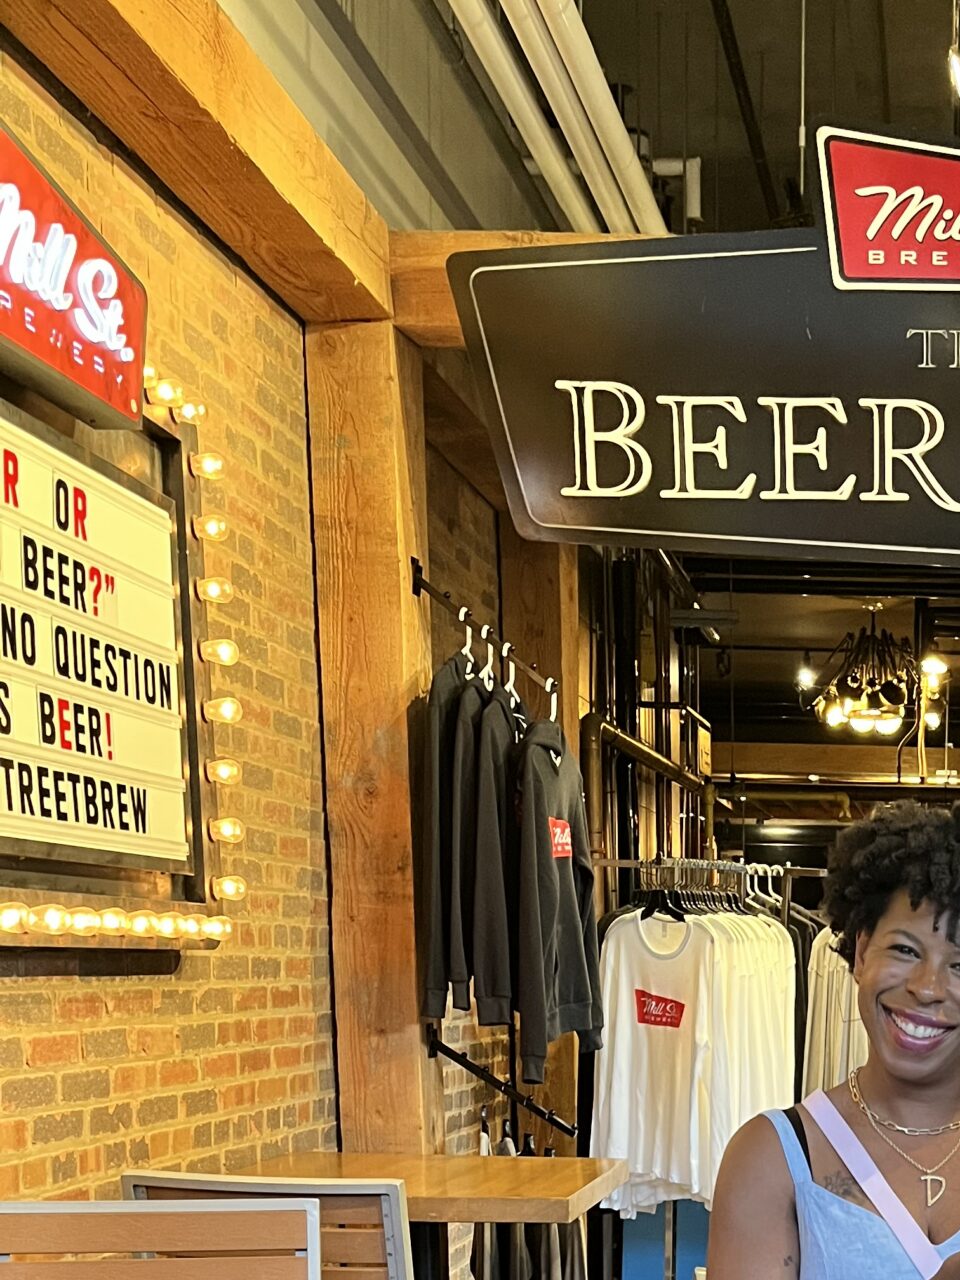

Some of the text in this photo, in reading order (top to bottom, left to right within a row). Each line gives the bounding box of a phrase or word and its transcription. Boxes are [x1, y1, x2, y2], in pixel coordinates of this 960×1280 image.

[73, 258, 135, 362] St.
[55, 478, 87, 541] OR
[1, 603, 172, 711] NO QUESTION
[39, 692, 113, 760] BEER!
[0, 757, 147, 834] TREETBREW
